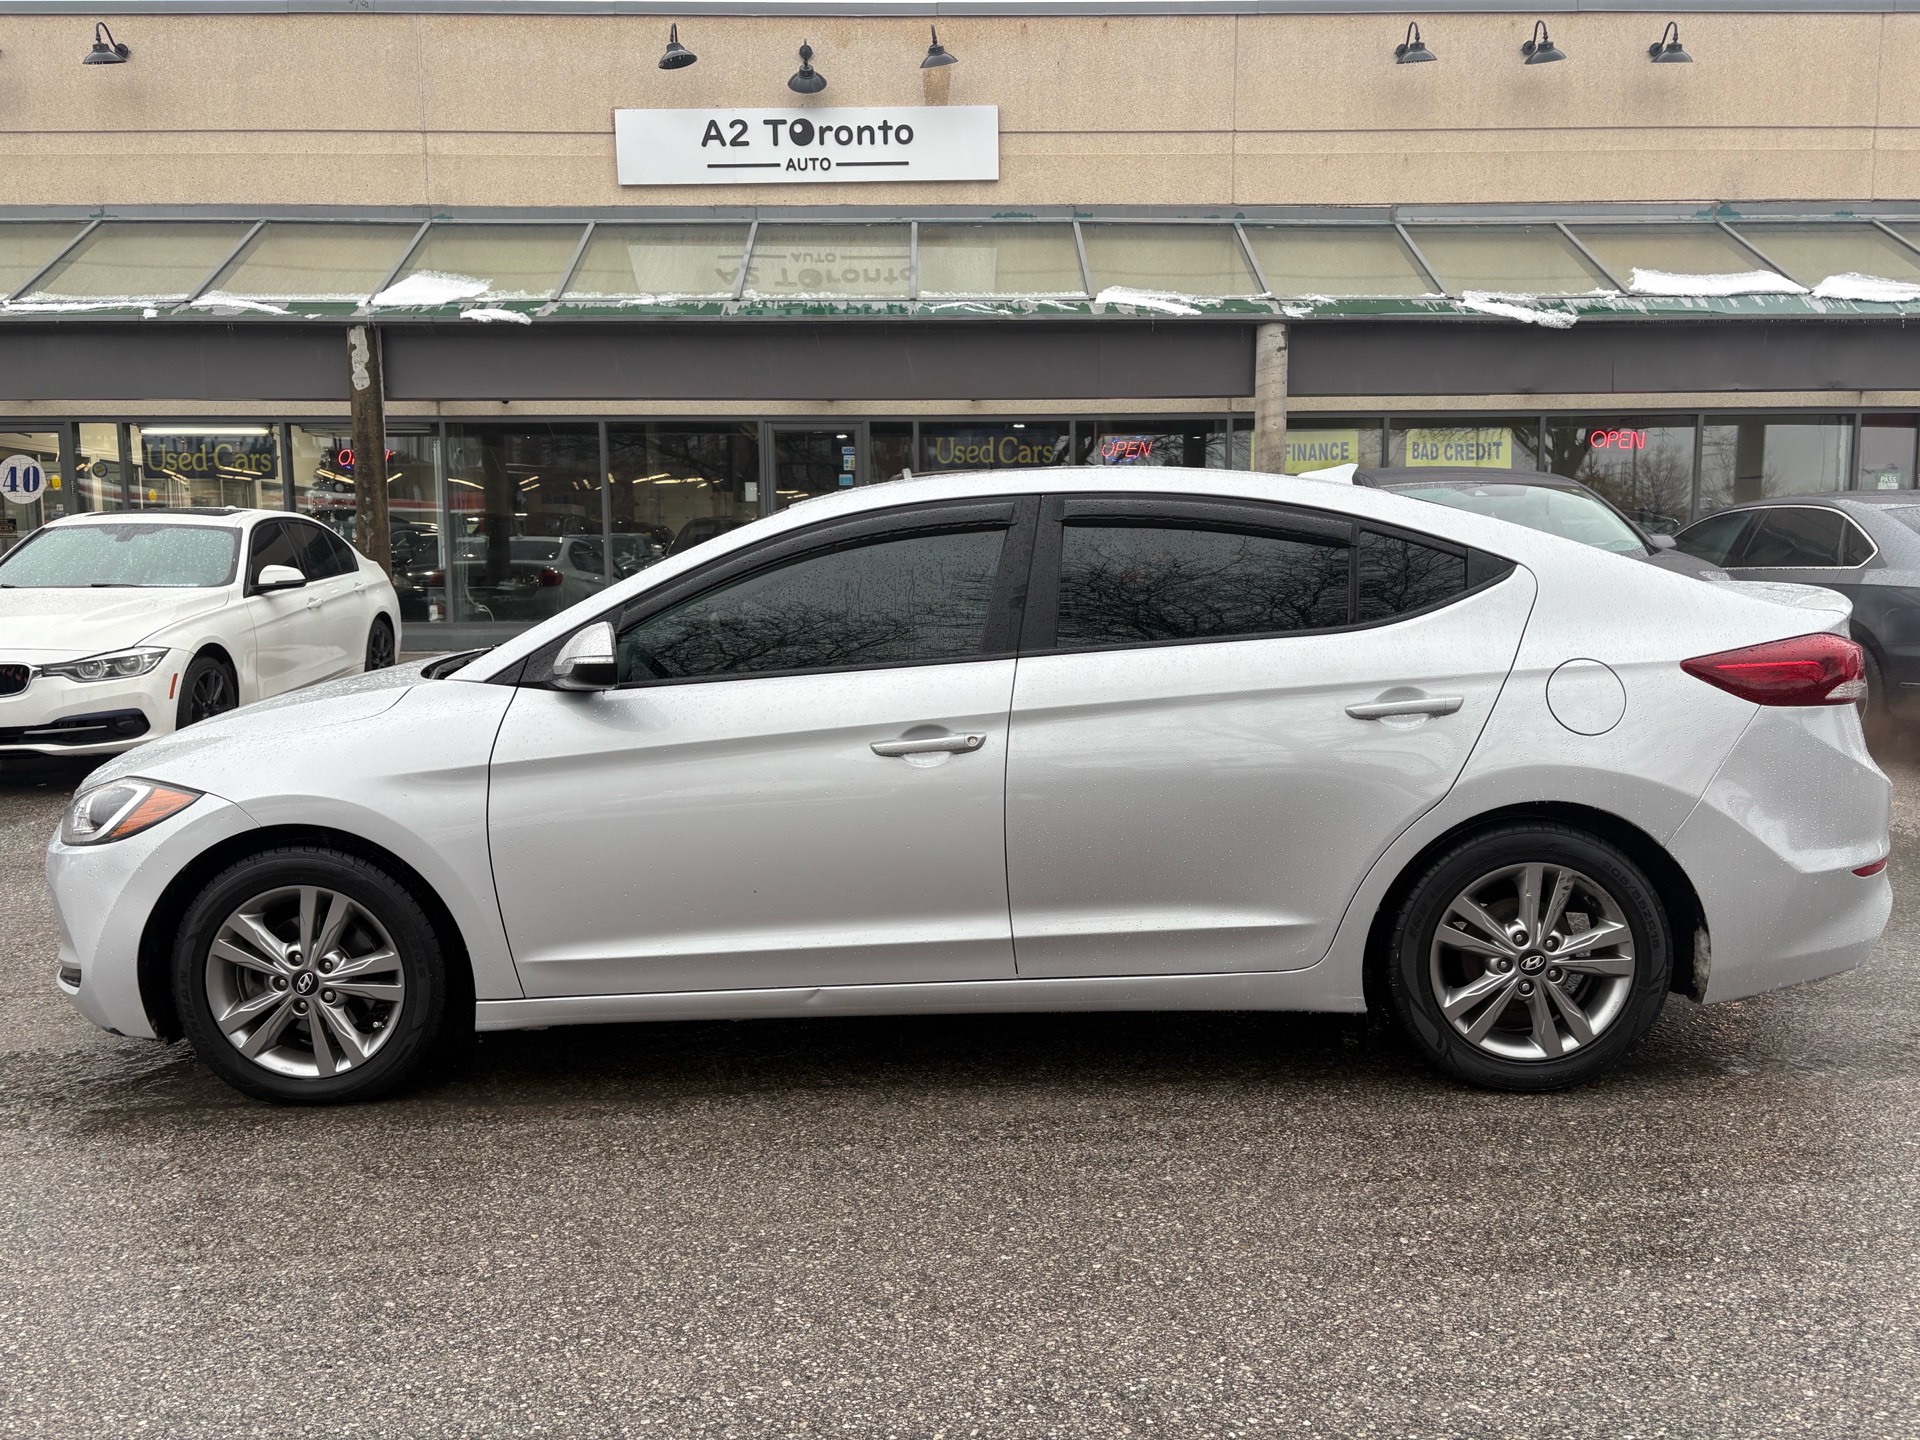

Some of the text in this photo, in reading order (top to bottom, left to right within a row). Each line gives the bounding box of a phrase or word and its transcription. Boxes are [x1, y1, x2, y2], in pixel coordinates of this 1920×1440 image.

[701, 119, 750, 147] A2
[785, 157, 832, 171] AUTO
[936, 436, 1055, 464] Used Cars
[1101, 441, 1153, 458] OPEN
[1590, 430, 1646, 450] OPEN
[146, 443, 272, 472] Used Cars
[1284, 442, 1349, 461] FINANCE
[1412, 442, 1503, 461] BAD CREDIT
[3, 466, 40, 493] 40
